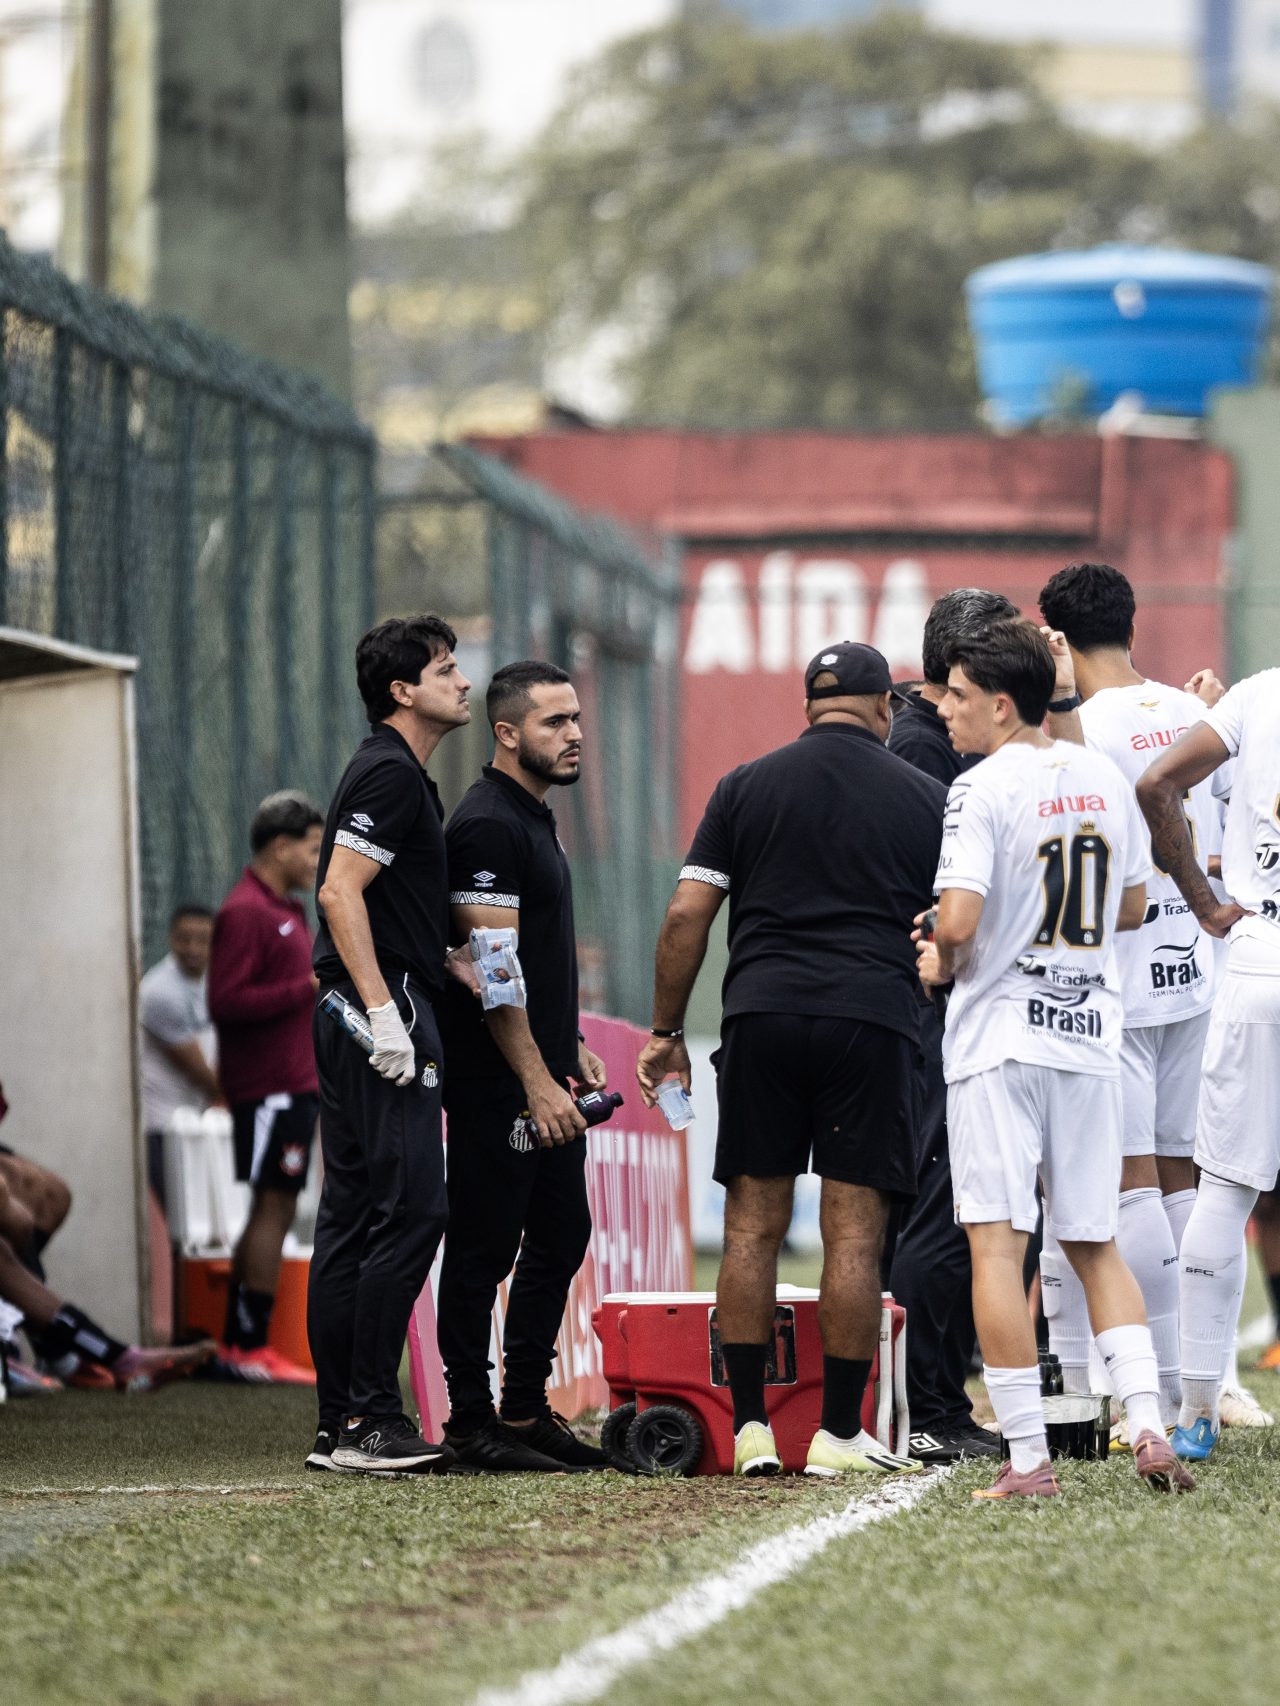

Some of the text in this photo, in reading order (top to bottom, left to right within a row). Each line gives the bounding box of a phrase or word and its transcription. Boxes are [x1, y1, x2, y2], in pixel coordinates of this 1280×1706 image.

[1038, 794, 1108, 818] aiwa
[350, 820, 370, 833] umbro
[1031, 832, 1113, 950] 10
[1163, 904, 1192, 916] Trad
[1027, 998, 1102, 1039] Brasil
